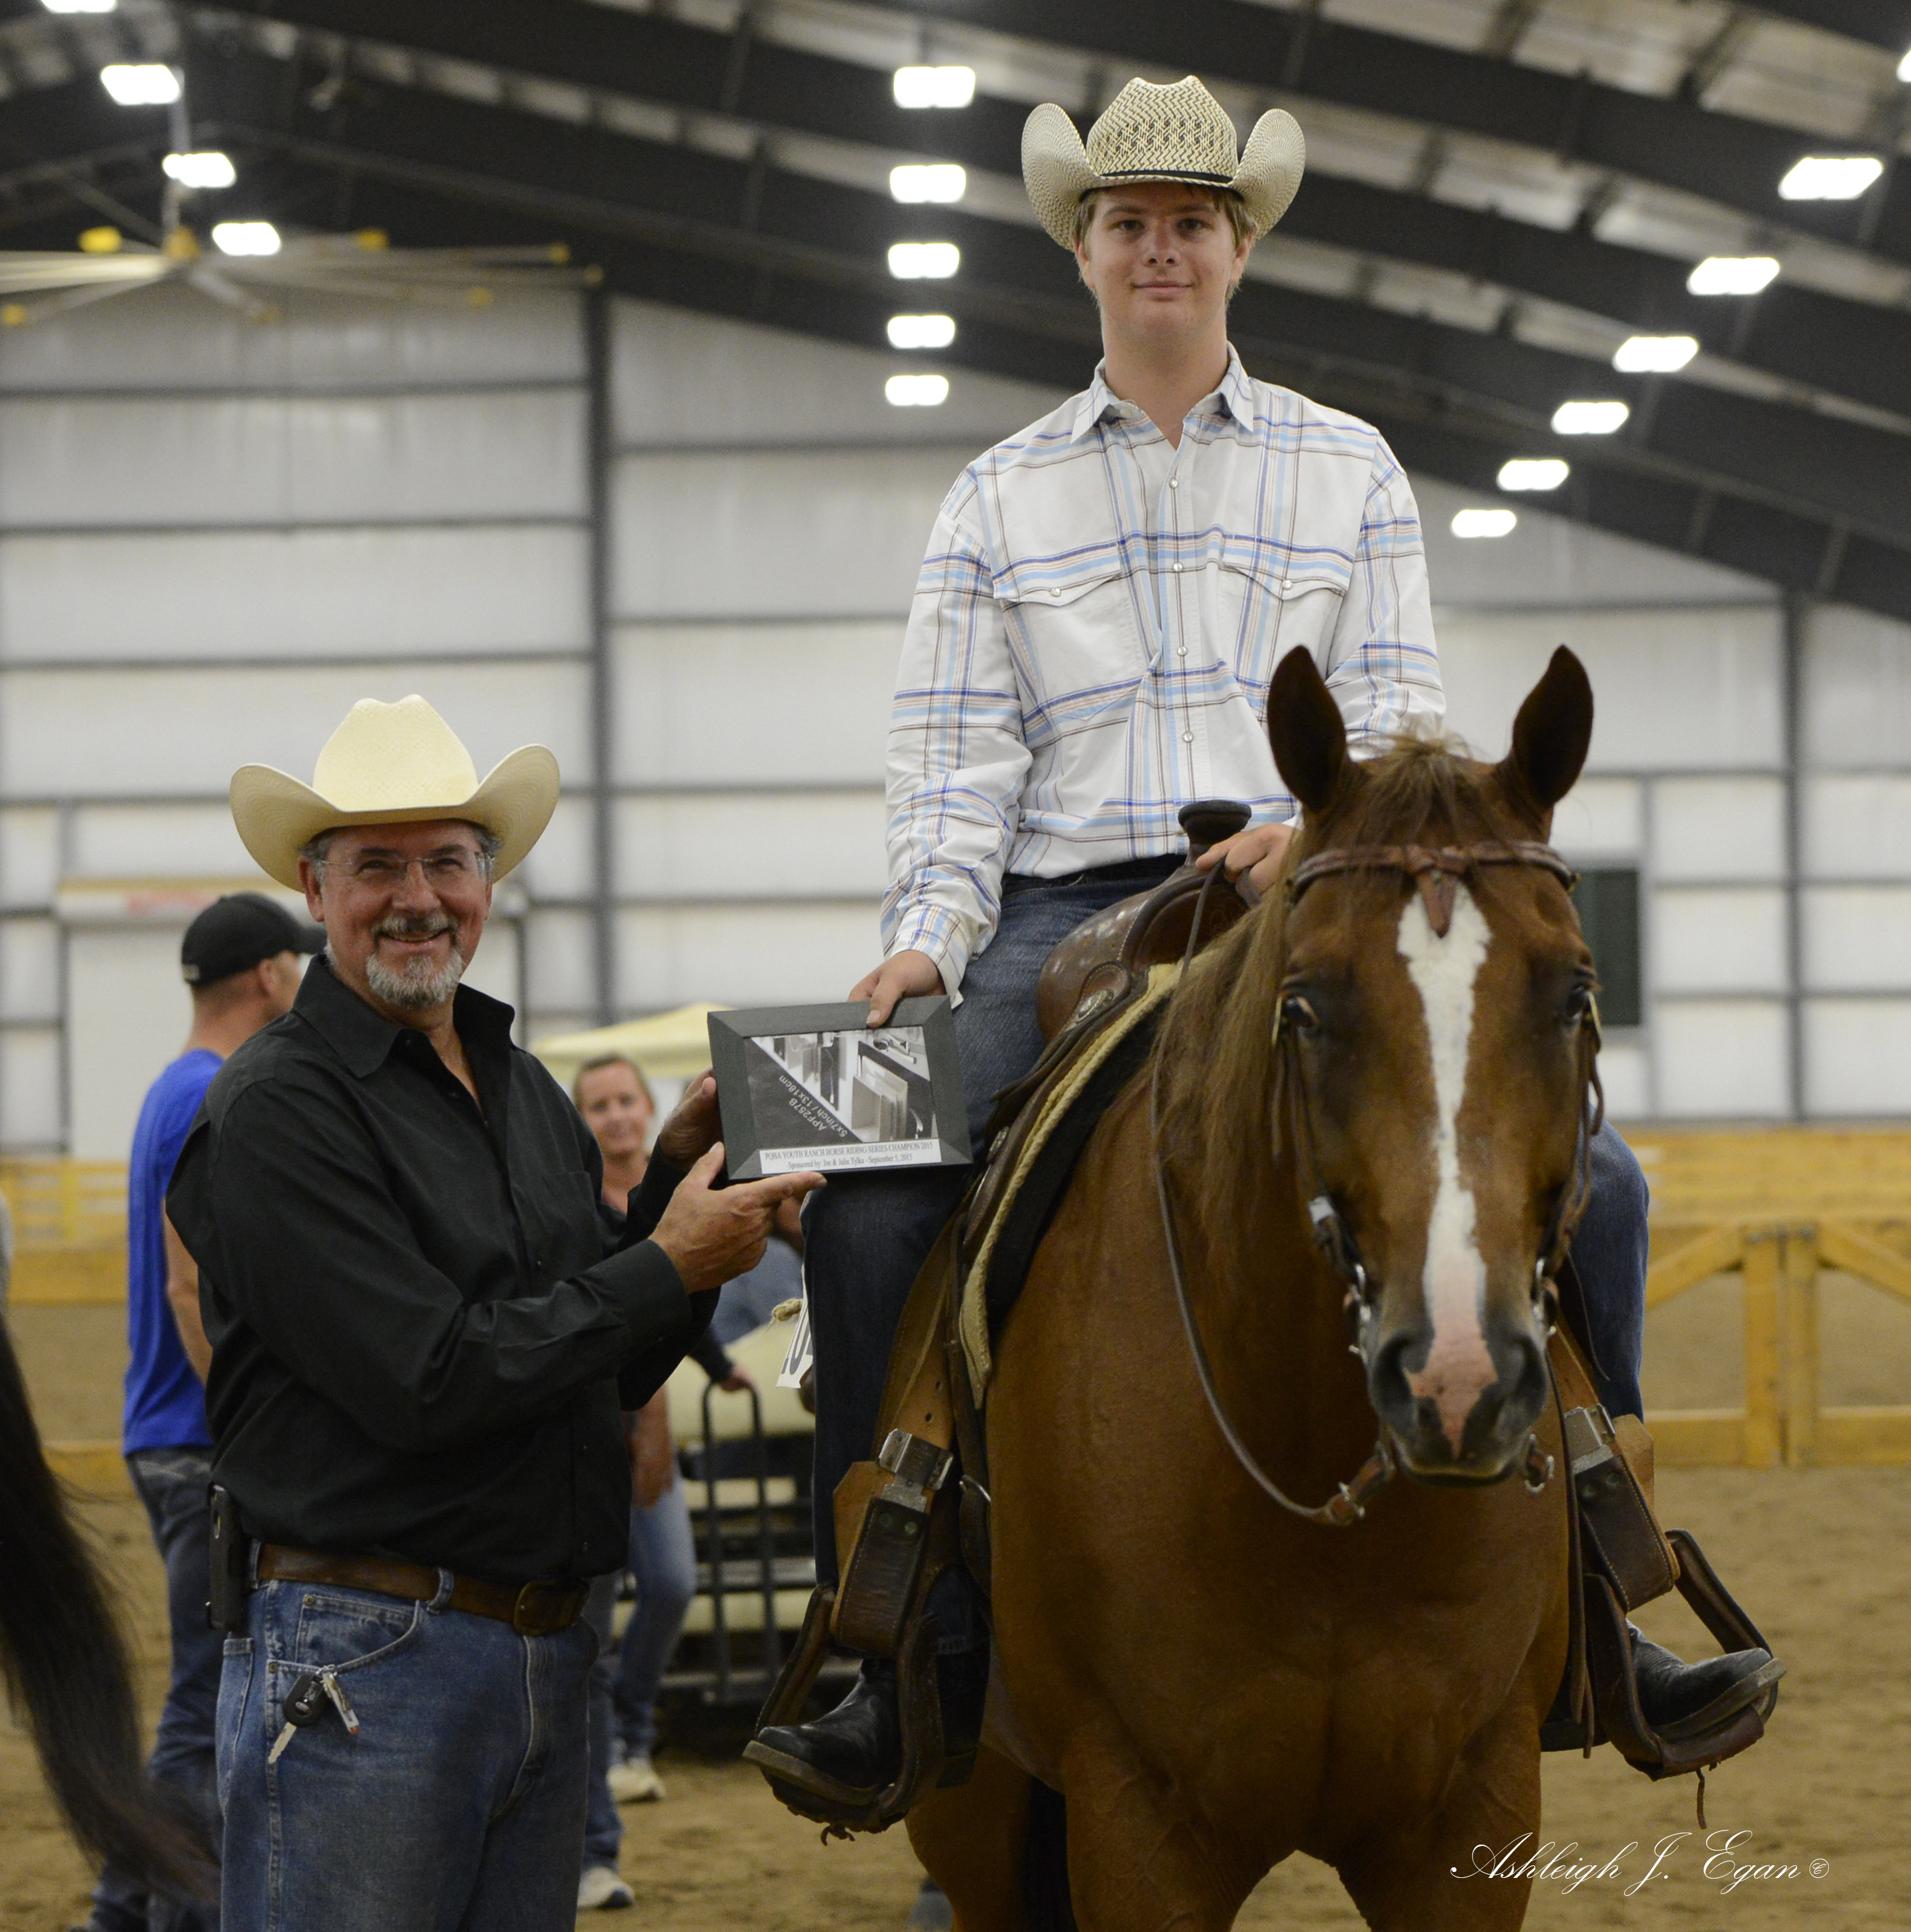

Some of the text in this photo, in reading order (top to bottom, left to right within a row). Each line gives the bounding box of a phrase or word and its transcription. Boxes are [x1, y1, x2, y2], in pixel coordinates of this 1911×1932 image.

[779, 1075, 813, 1107] 13x18cm
[789, 1098, 827, 1131] APF257B
[765, 1141, 933, 1160] PQHA YOUTH RANCH HORSE RIDING SERIES CHAMPION 2015
[788, 1160, 813, 1170] Sponsored
[869, 1155, 893, 1165] September
[901, 1153, 913, 1161] 2015
